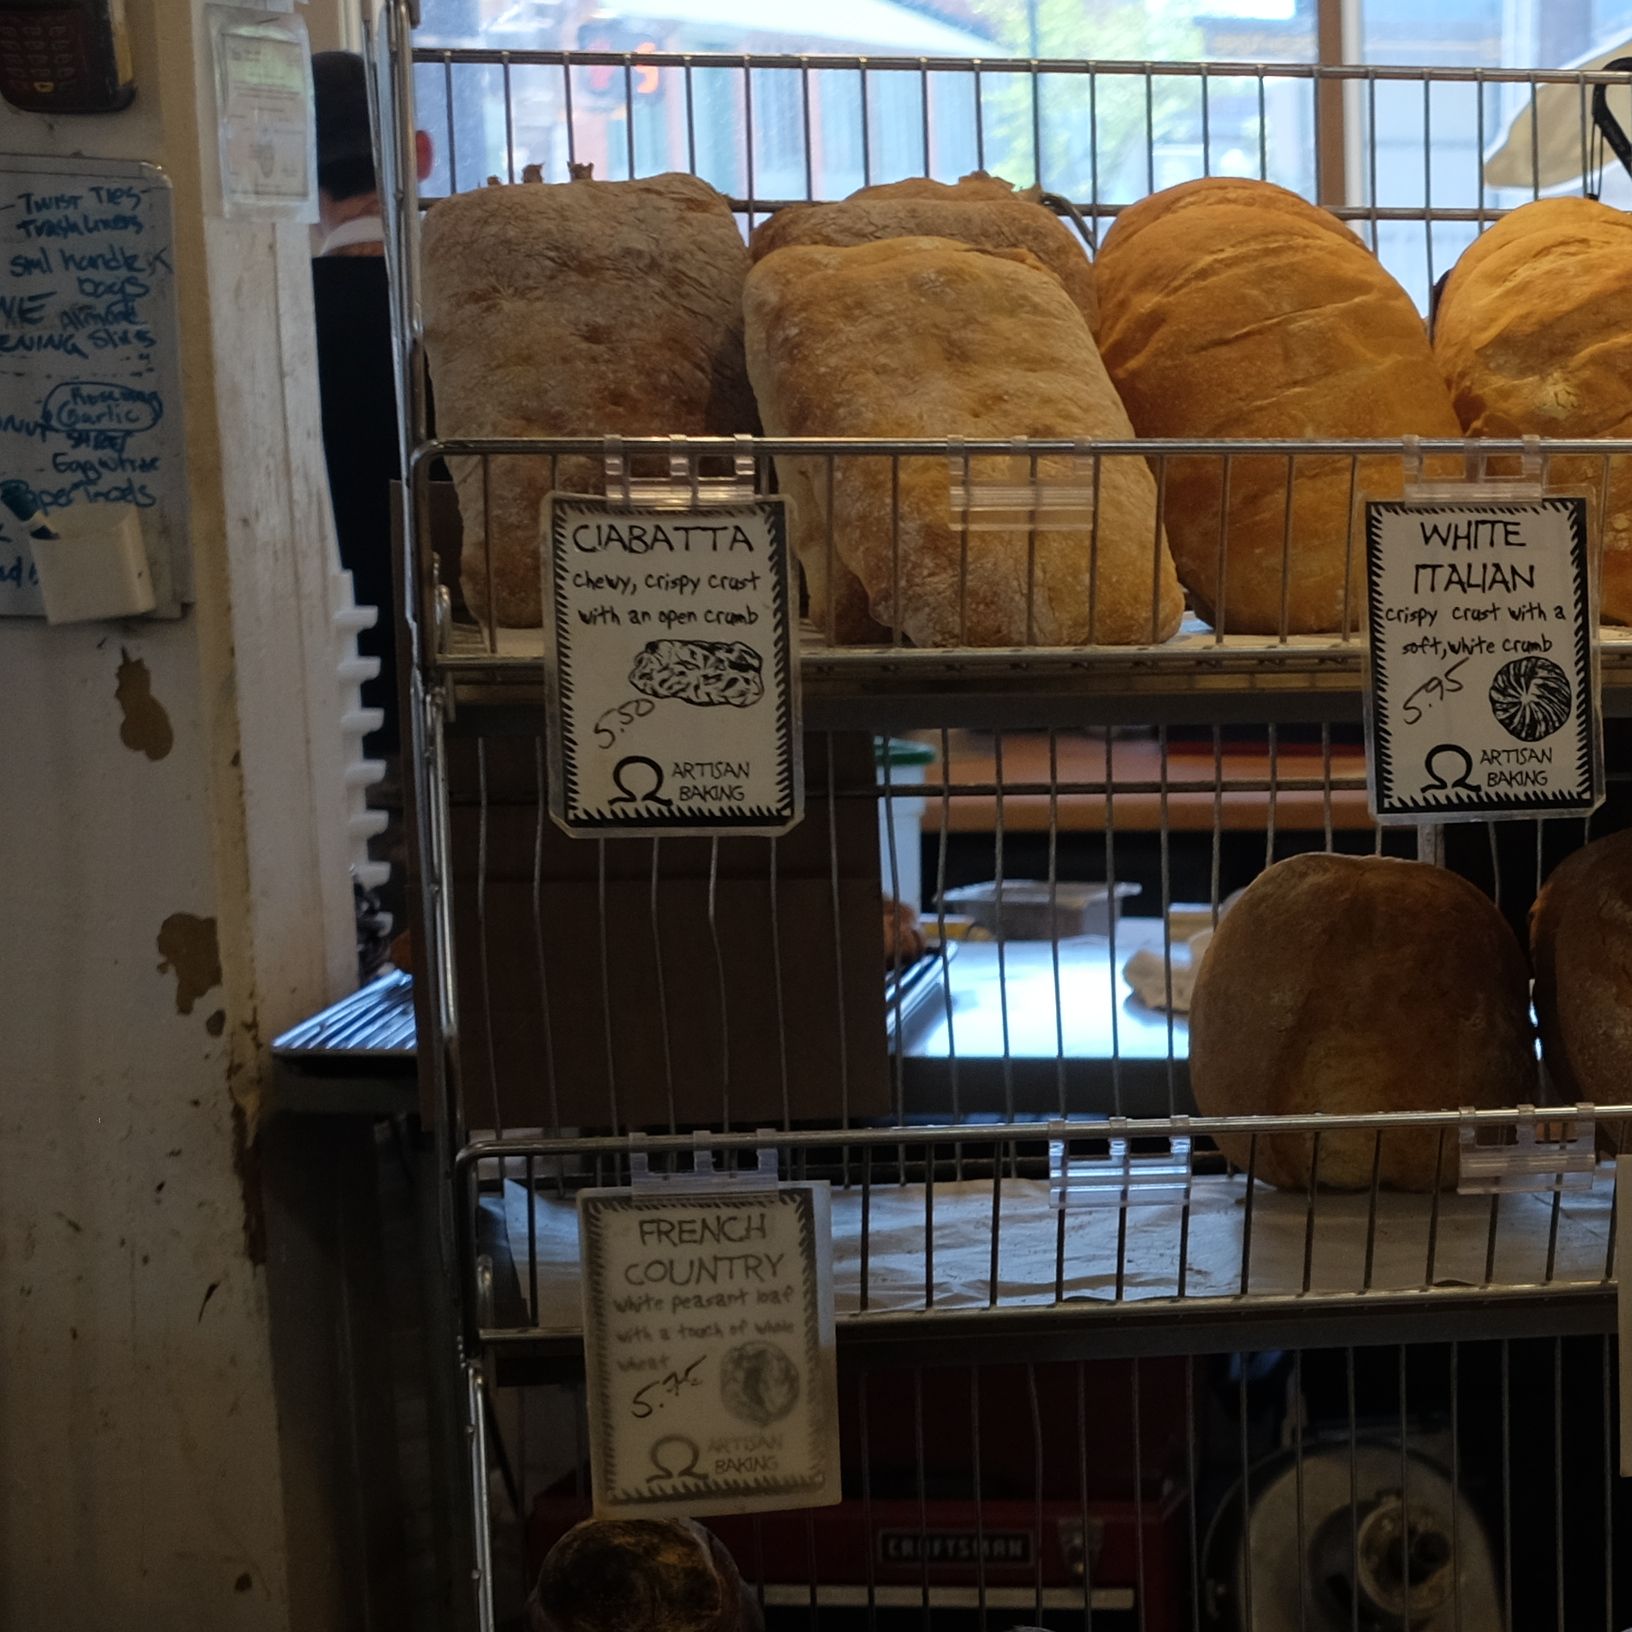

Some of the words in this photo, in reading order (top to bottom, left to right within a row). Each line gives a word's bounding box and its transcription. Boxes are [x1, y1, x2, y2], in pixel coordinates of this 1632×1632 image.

[573, 524, 754, 553] CIABATTA
[1421, 520, 1526, 550] WHITE
[573, 570, 637, 594] chewy,
[645, 572, 699, 594] crispy
[708, 571, 761, 589] crust
[1414, 564, 1535, 594] ITALIAN
[579, 606, 620, 625] with
[630, 609, 651, 624] an
[659, 610, 696, 628] open
[704, 606, 759, 625] crumb
[1386, 606, 1437, 626] crispy
[1452, 606, 1500, 620] crust
[1509, 603, 1547, 620] with
[1554, 606, 1566, 619] a
[1503, 635, 1552, 651] crumb
[1402, 657, 1469, 724] 5.95
[593, 699, 655, 749] 5.50
[1480, 748, 1552, 765] ARTISAN
[672, 762, 750, 779] ARTISAN
[1487, 770, 1548, 786] BAKING
[679, 784, 745, 801] BAKING
[639, 1213, 766, 1247] FRENCH
[625, 1254, 784, 1286] COUNTRY
[673, 1291, 749, 1314] peasant
[716, 1455, 779, 1474] BAKING
